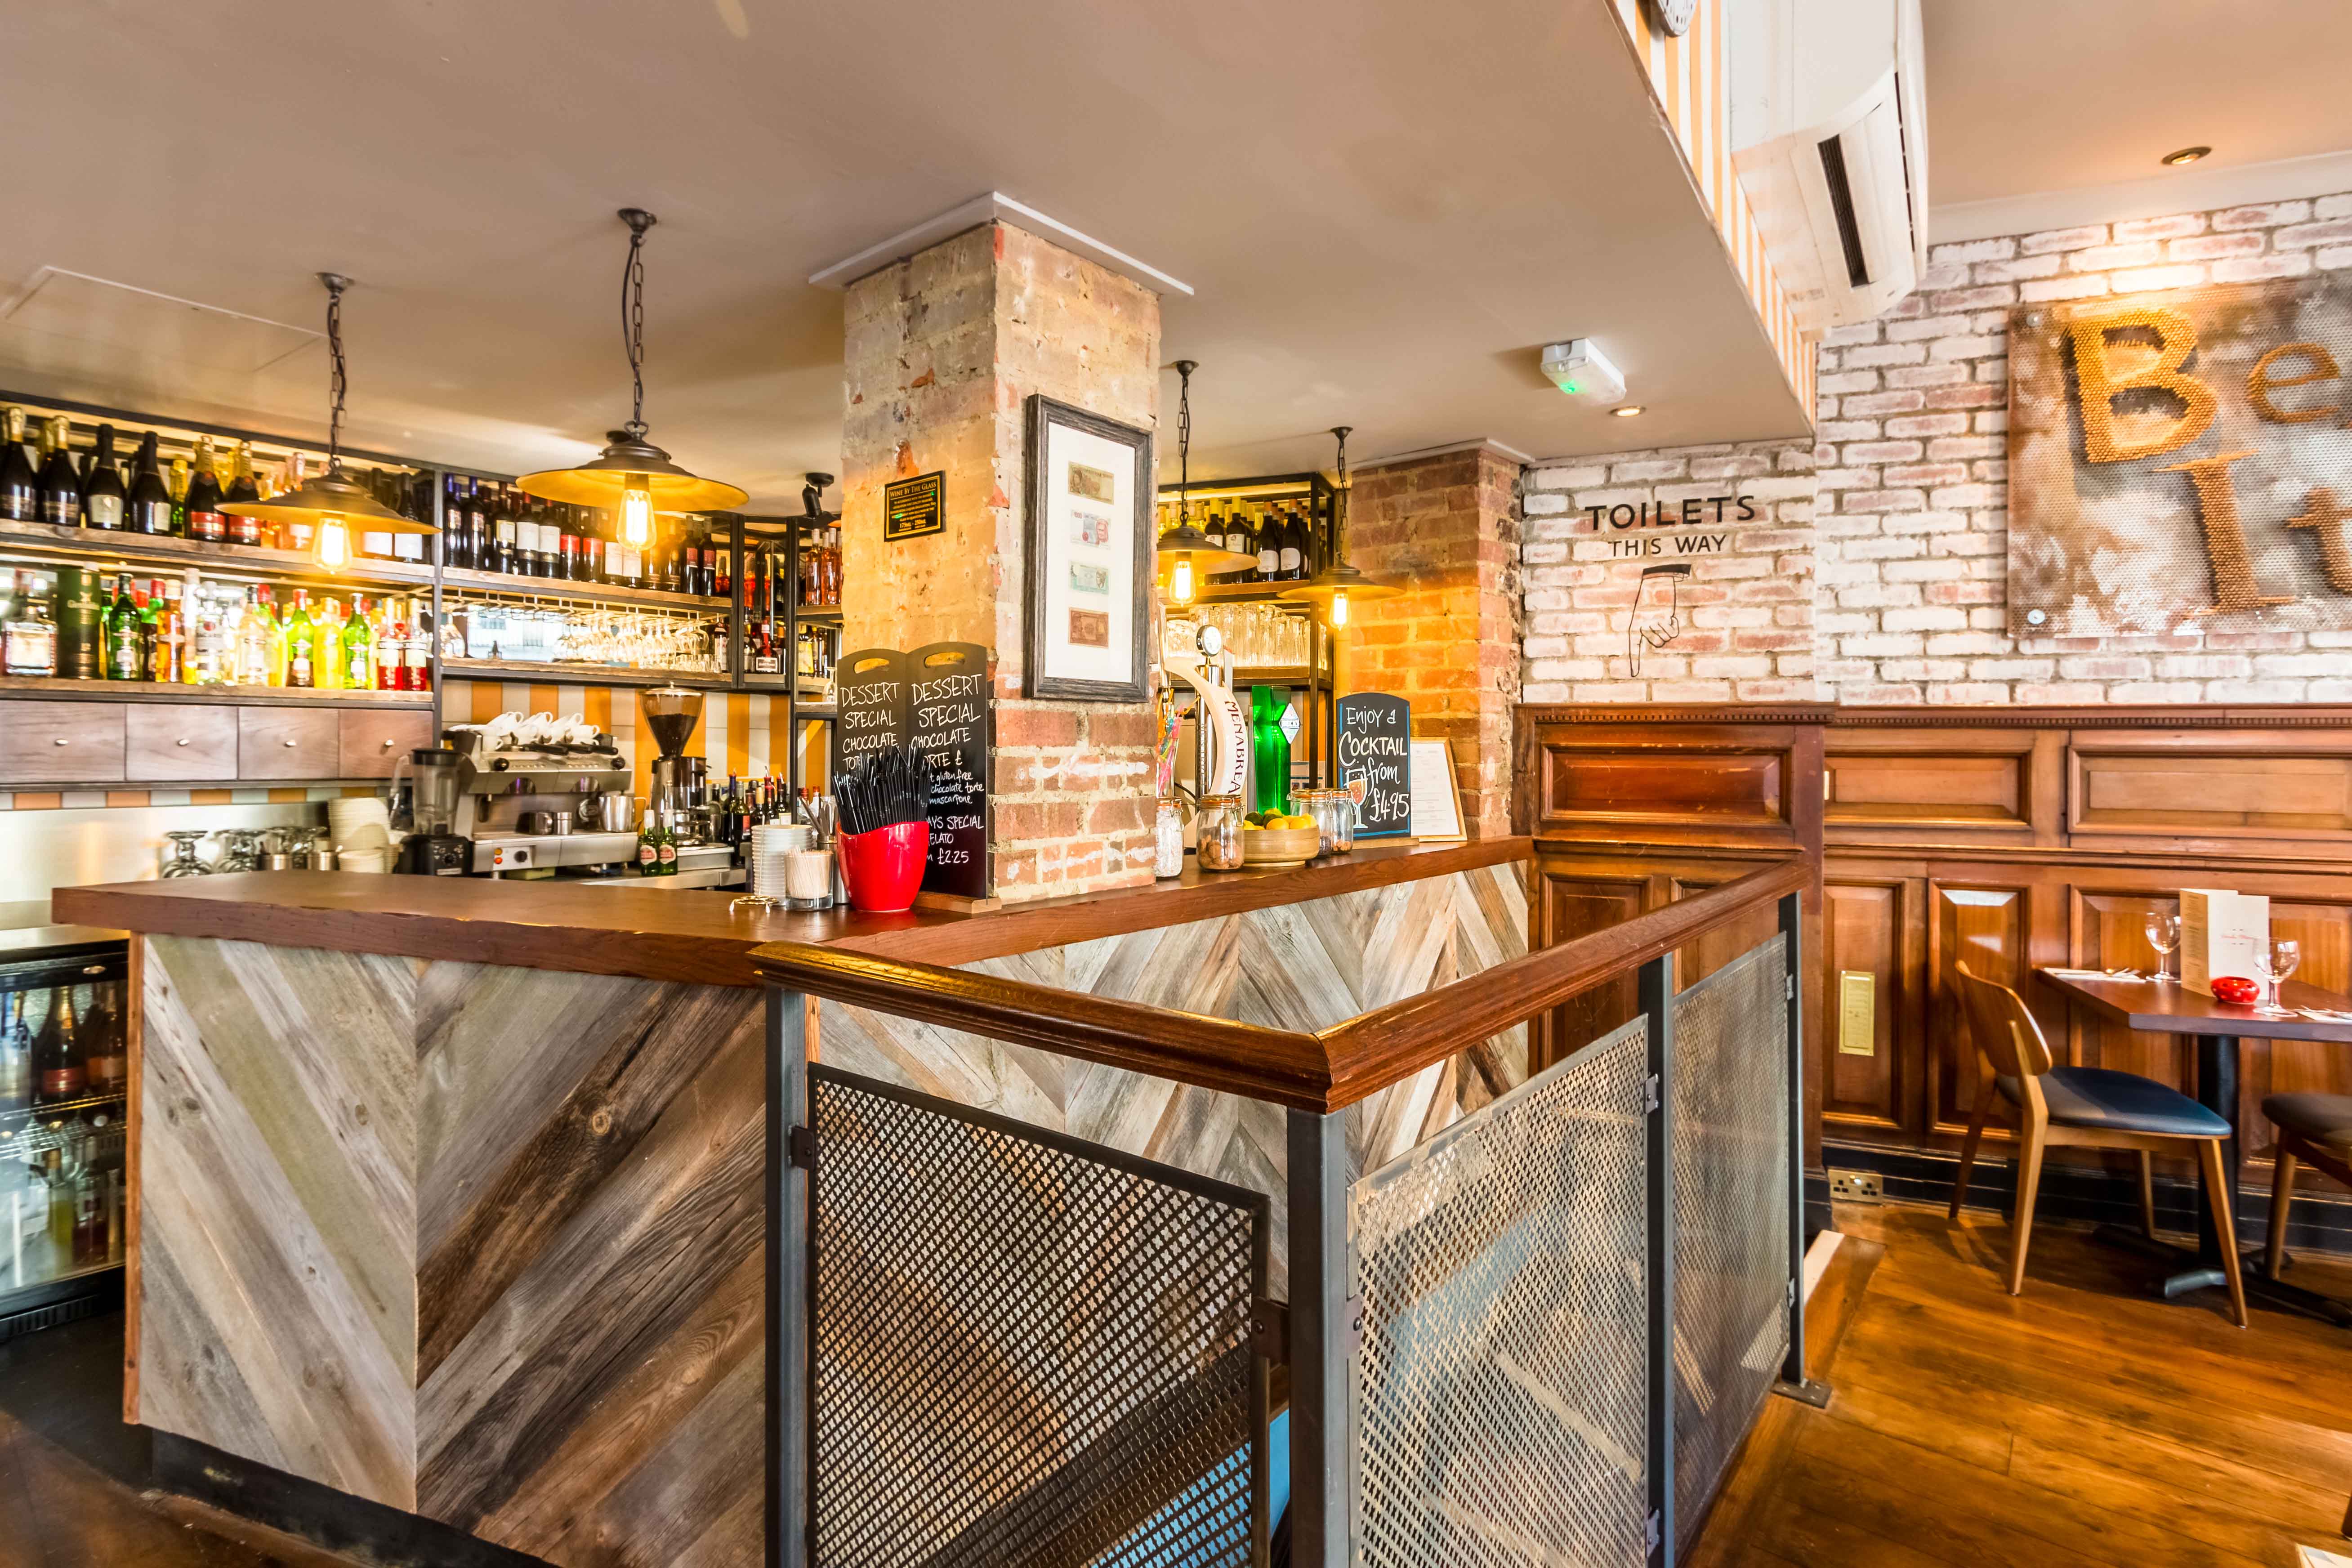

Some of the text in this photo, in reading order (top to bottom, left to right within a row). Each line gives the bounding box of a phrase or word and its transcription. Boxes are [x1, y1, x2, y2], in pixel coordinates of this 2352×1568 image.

[1584, 496, 1754, 531] TOILETS
[1607, 534, 1727, 557] THIS WAY
[840, 682, 900, 708] DESSERT
[911, 674, 982, 706] DESSERT
[845, 709, 897, 729] SPECIAL
[918, 703, 981, 728] SPECIAL
[1387, 709, 1396, 724] a
[843, 732, 898, 754] CHOCOLATE
[911, 727, 971, 750] CHOCOLATE
[1224, 701, 1245, 794] MENABREA
[1339, 731, 1407, 767] COCKTAIL
[930, 782, 985, 794] chocolate torte
[936, 770, 956, 786] gluten
[956, 769, 973, 783] free
[1367, 757, 1401, 797] from
[929, 794, 973, 805] mascarpone
[1369, 788, 1410, 822] £4.95
[926, 815, 984, 830] AYS SPECIAL
[928, 833, 954, 846] ELATO
[937, 847, 969, 865] £2.25
